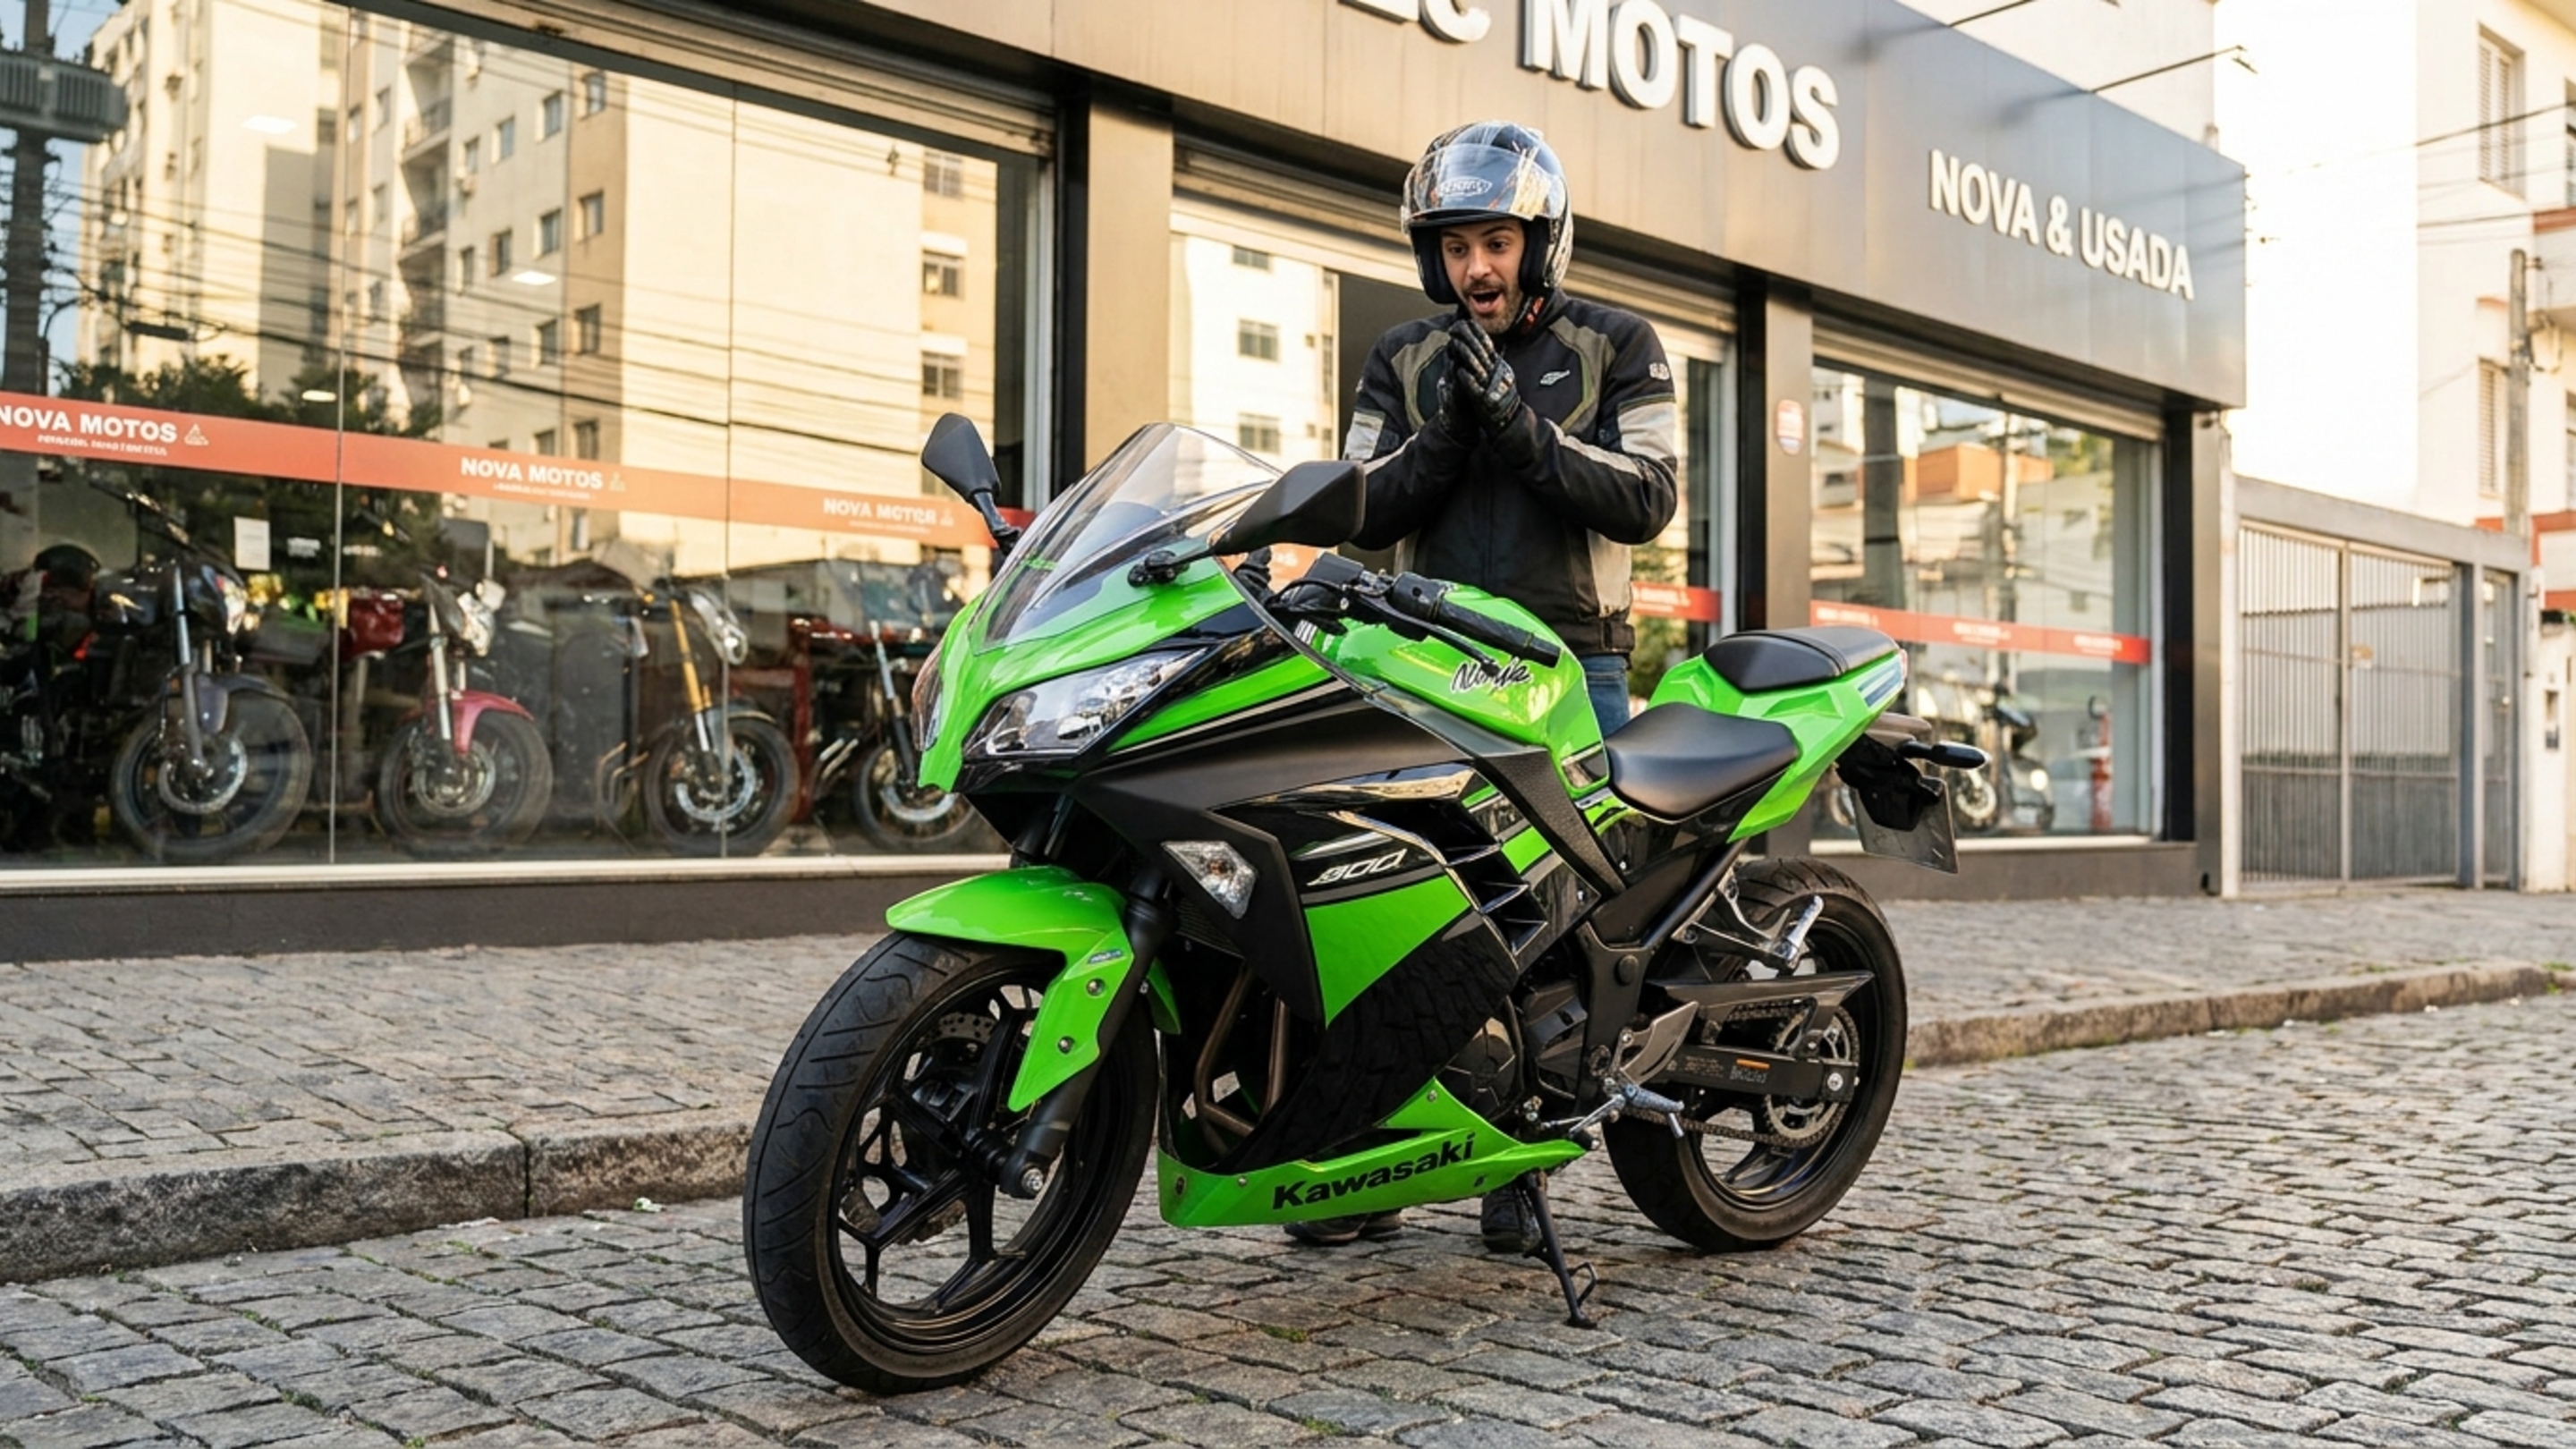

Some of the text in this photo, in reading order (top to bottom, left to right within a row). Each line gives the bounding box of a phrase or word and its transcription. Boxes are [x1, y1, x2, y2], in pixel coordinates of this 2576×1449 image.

[1521, 0, 1840, 170] MOTOS
[1929, 148, 2195, 301] NOVA & USADA
[0, 405, 177, 443] NOVA MOTOS
[461, 457, 604, 489] NOVA MOTOS
[1272, 1131, 1476, 1210] Kawasaki
